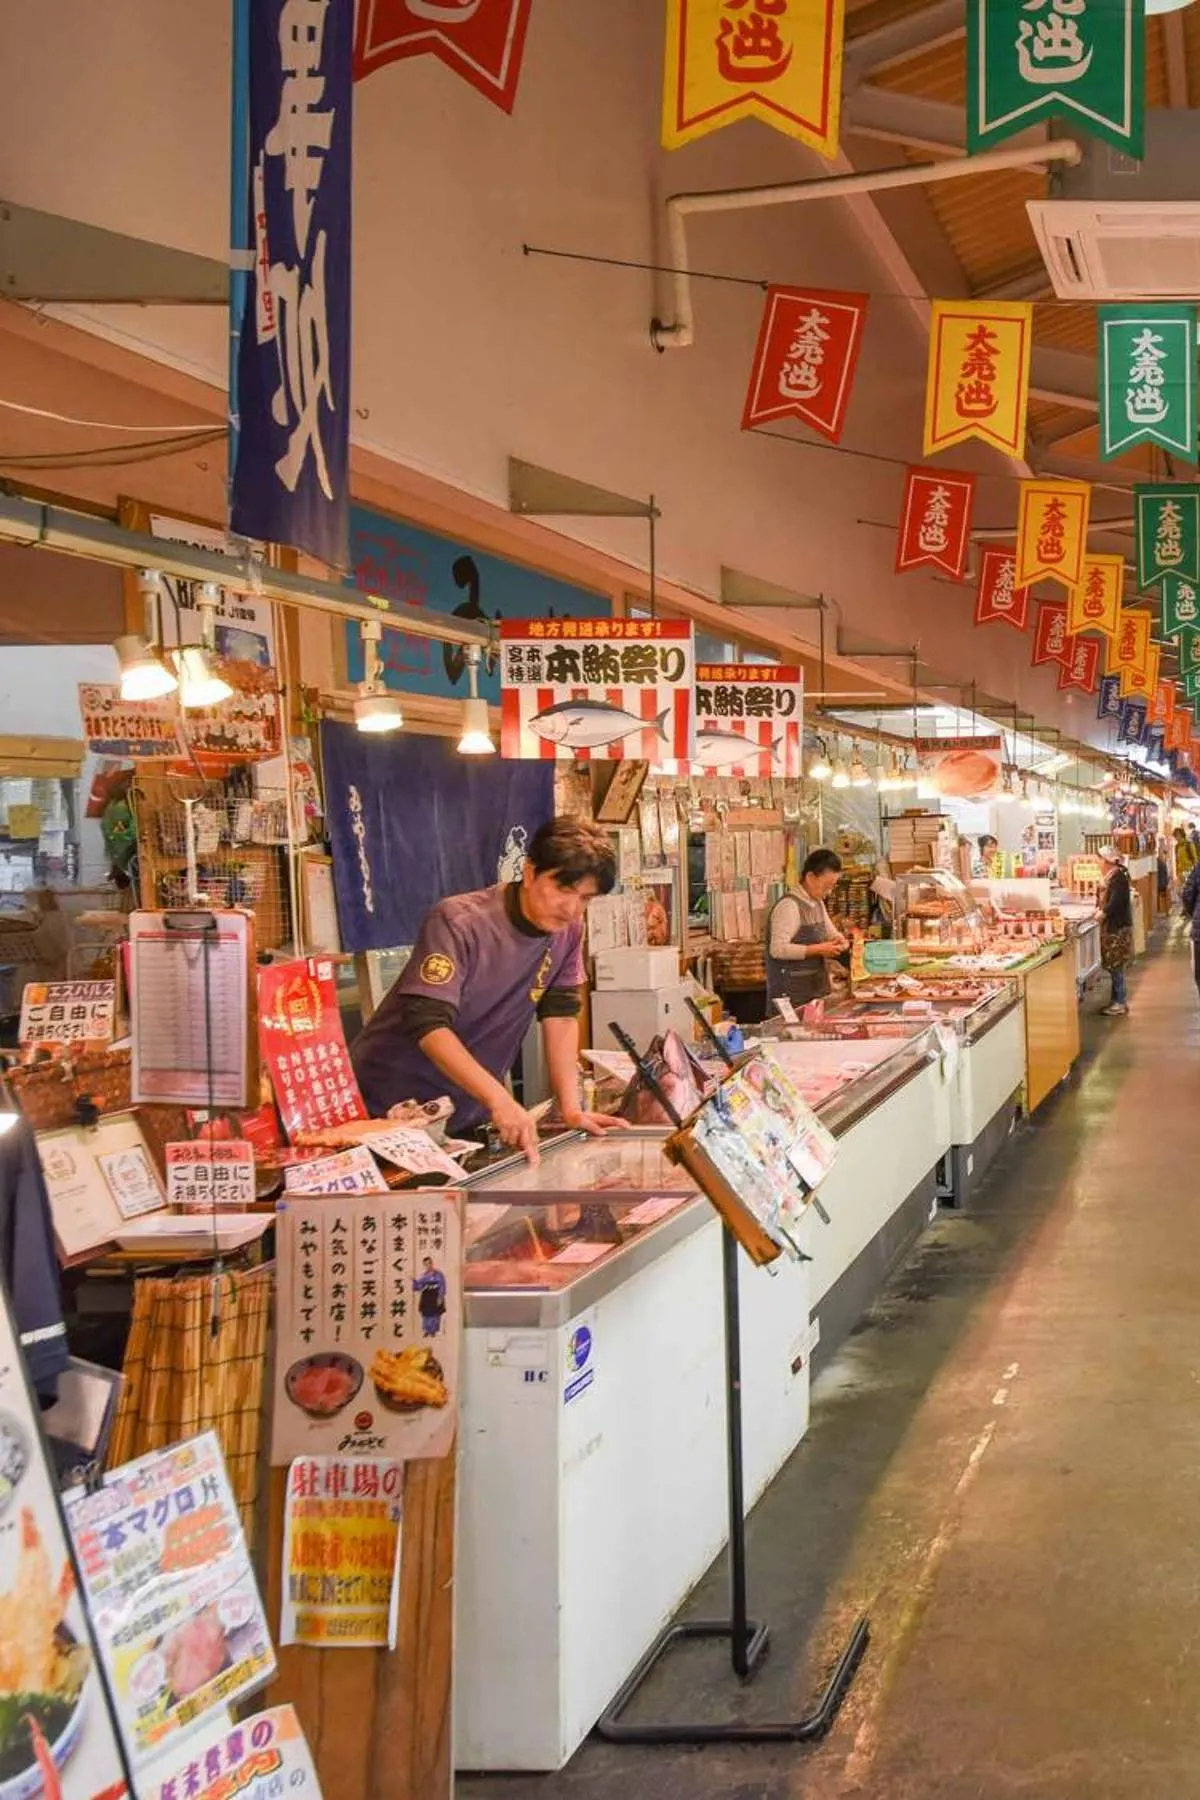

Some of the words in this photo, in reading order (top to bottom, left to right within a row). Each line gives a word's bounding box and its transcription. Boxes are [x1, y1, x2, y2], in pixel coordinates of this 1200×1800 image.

[545, 643, 686, 684] 本鮪祭り
[28, 1003, 108, 1021] ご自由に
[173, 1165, 250, 1181] ご自由に
[300, 1219, 318, 1344] みやもとです
[329, 1217, 348, 1343] 人気のお店!
[360, 1215, 379, 1340] あなご天丼で
[391, 1213, 408, 1338] 本まぐろ丼と
[292, 1461, 401, 1498] 駐車場の
